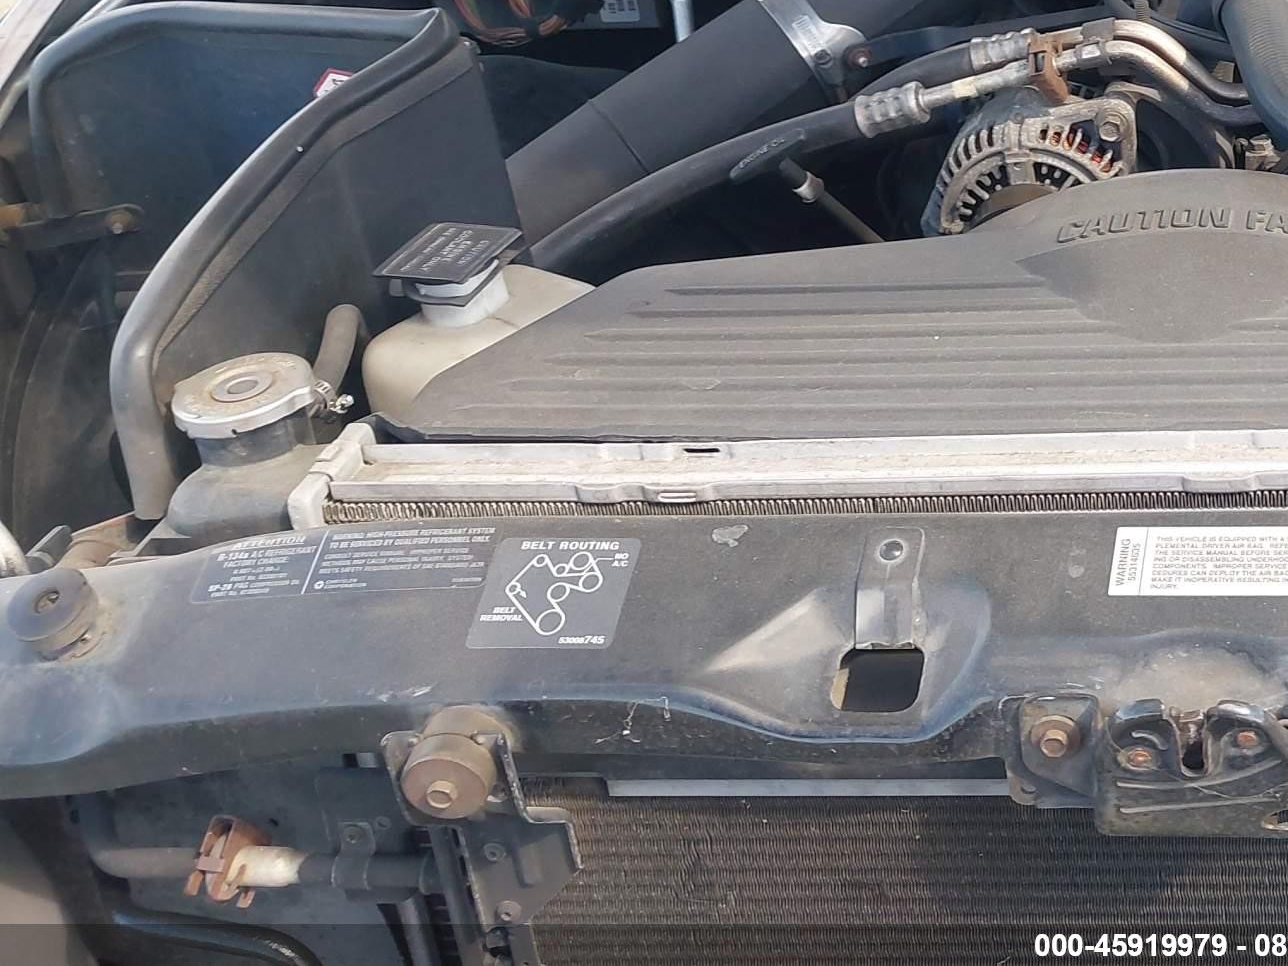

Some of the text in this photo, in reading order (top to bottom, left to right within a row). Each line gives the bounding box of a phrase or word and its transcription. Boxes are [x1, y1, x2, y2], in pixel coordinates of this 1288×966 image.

[1057, 209, 1231, 243] CAUTION
[520, 541, 620, 550] BELT ROUTING
[1115, 538, 1131, 586] WARNING
[492, 606, 516, 614] BELT
[479, 614, 524, 622] REMOVAL
